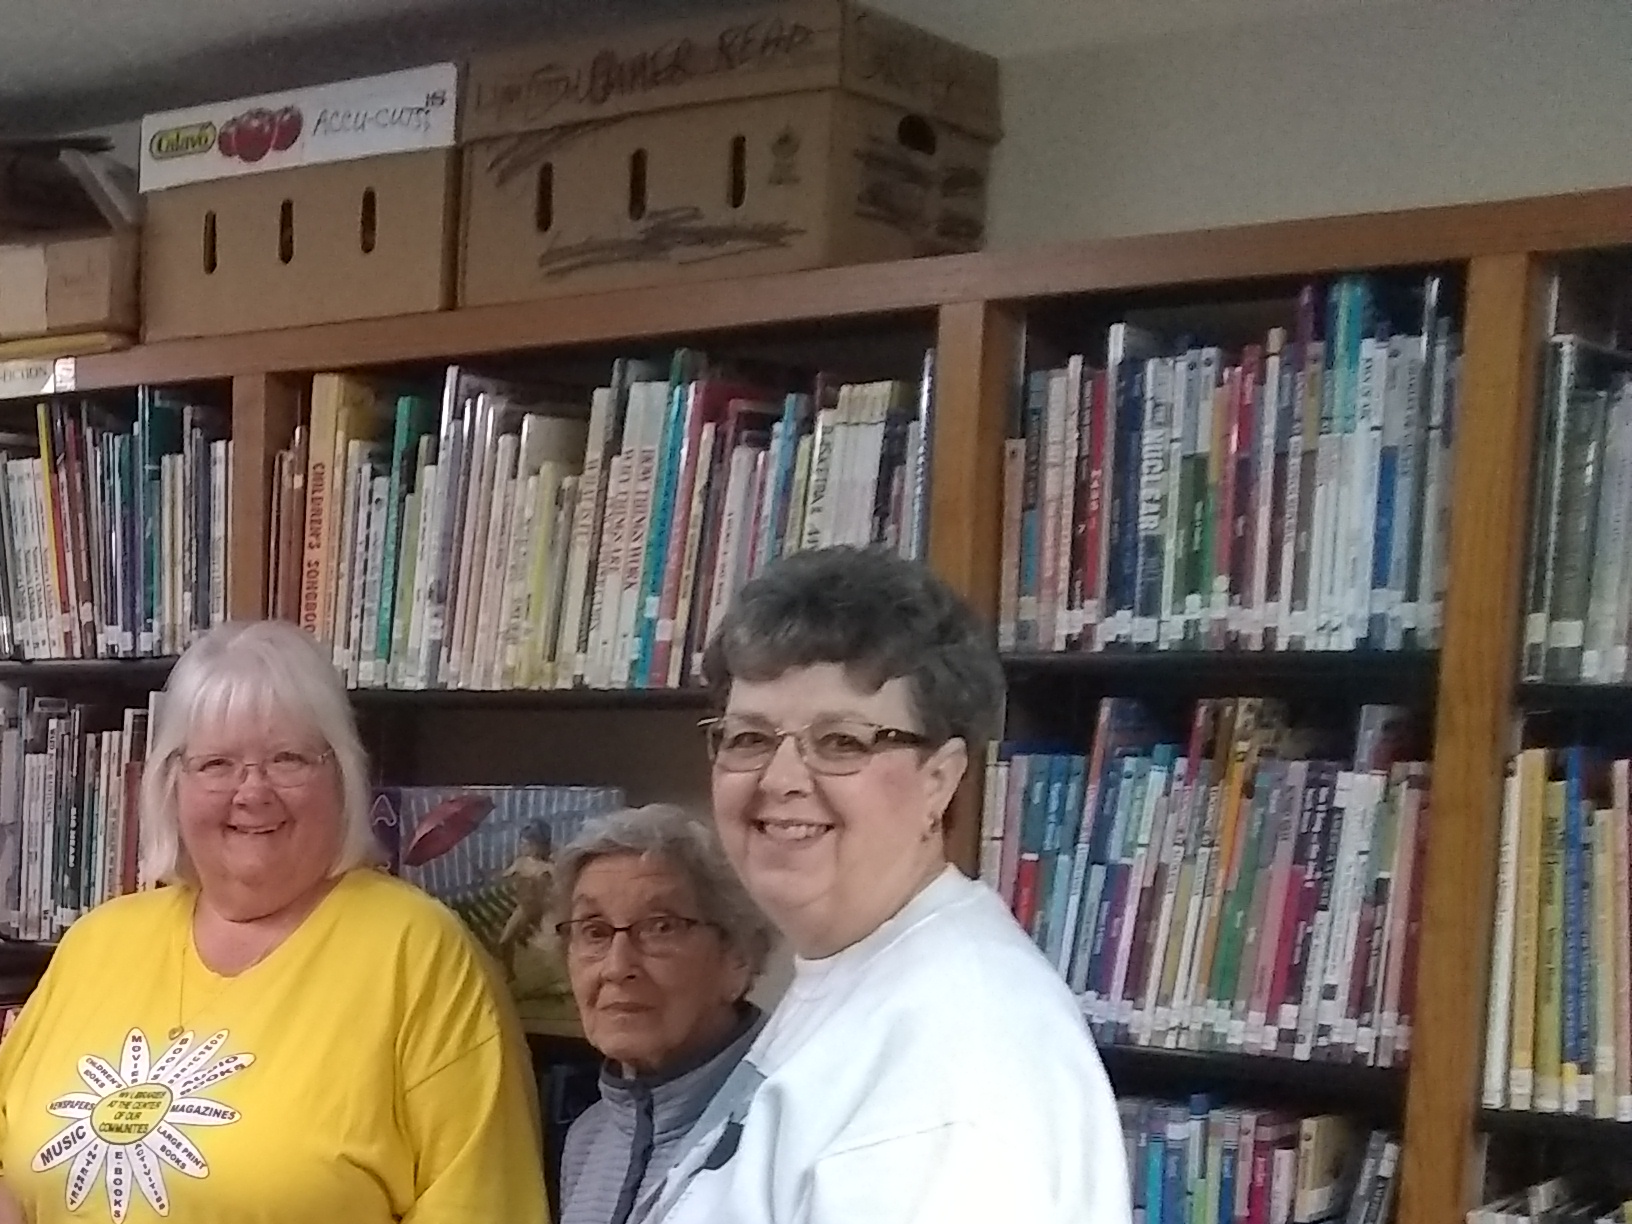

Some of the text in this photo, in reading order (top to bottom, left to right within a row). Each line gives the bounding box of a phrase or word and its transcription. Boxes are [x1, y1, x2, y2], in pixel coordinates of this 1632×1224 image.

[1139, 429, 1165, 532] NUCLEAR
[304, 560, 320, 634] SONGBOO
[83, 1069, 106, 1089] BOOKS
[86, 1057, 122, 1089] CHILDREN'S
[49, 1101, 96, 1111] NEWSPAPERS
[114, 1112, 141, 1120] OF OUR
[132, 1101, 161, 1109] CENTER
[170, 1104, 236, 1120] MAGAZINES
[99, 1124, 149, 1134] COMMUNITIES
[40, 1126, 87, 1166] MUSIC
[157, 1126, 206, 1169] LARGE PRINT
[160, 1145, 186, 1169] BOOKS
[70, 1144, 98, 1205] INTERNET
[114, 1152, 123, 1218] E-BOOKS
